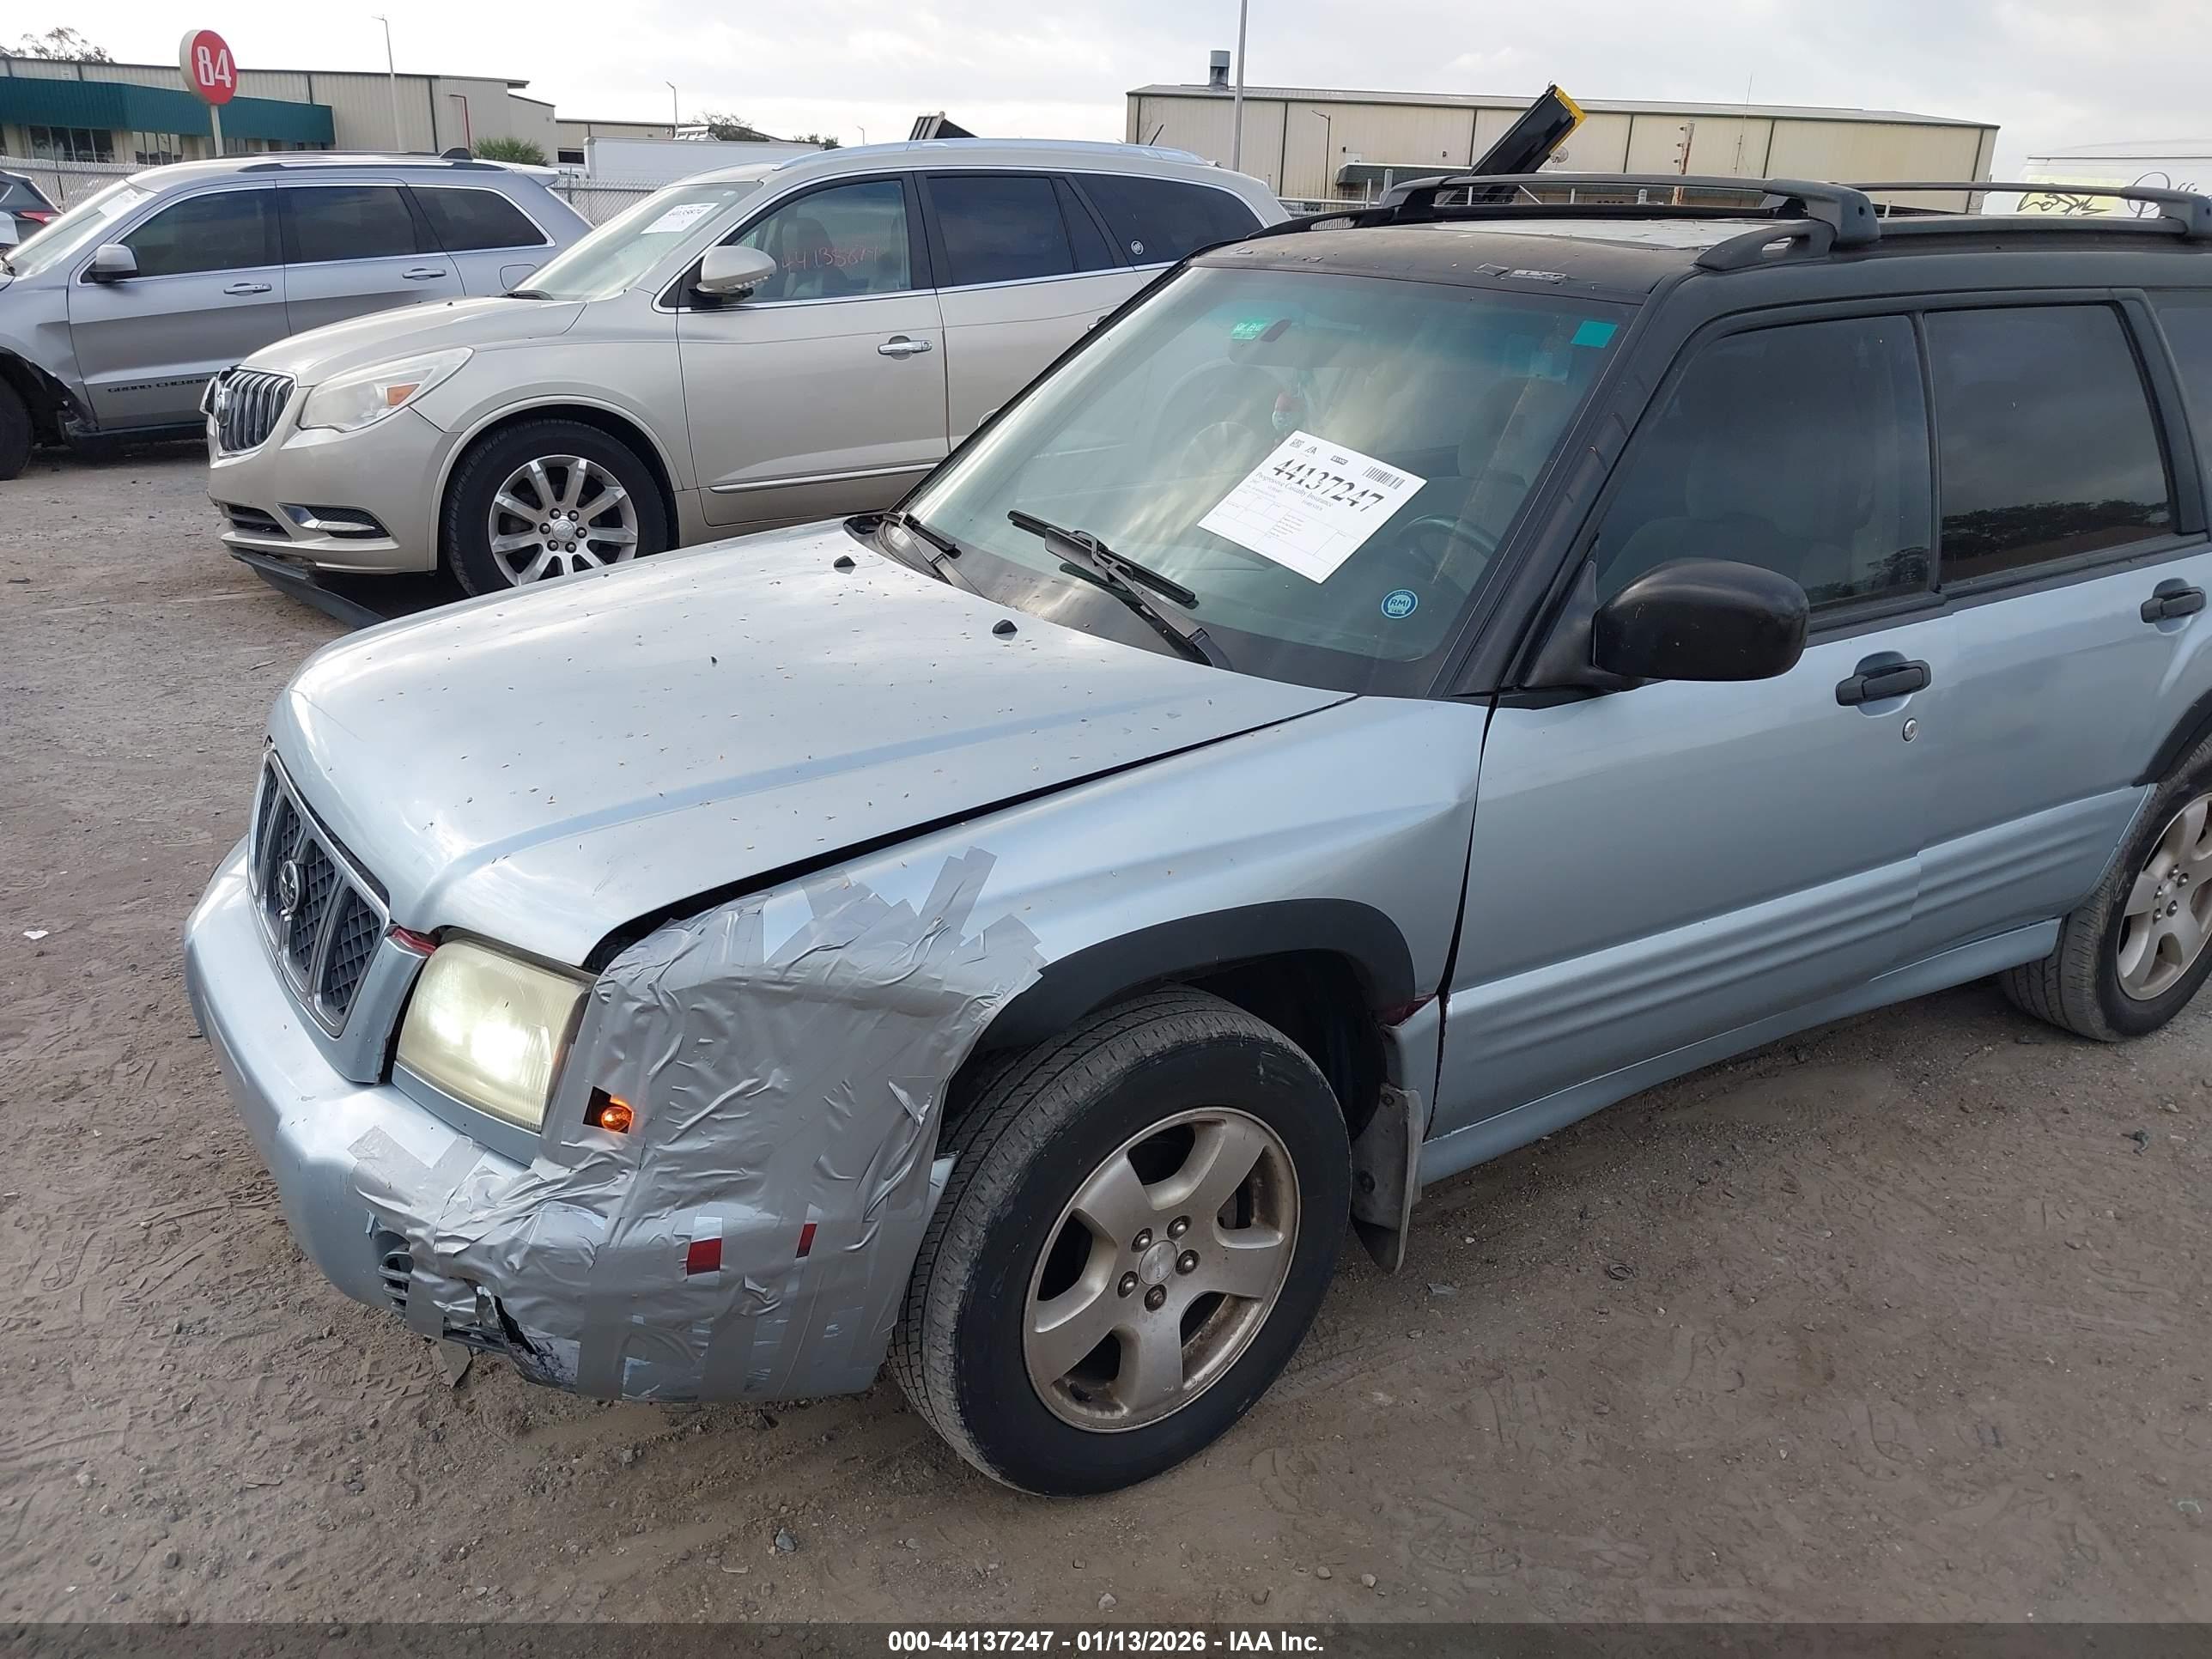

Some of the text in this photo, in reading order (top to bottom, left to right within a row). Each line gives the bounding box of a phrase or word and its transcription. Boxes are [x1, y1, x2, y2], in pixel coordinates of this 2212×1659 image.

[197, 46, 232, 88] 84
[1272, 458, 1385, 513] 44137247
[1389, 599, 1410, 608] RMI
